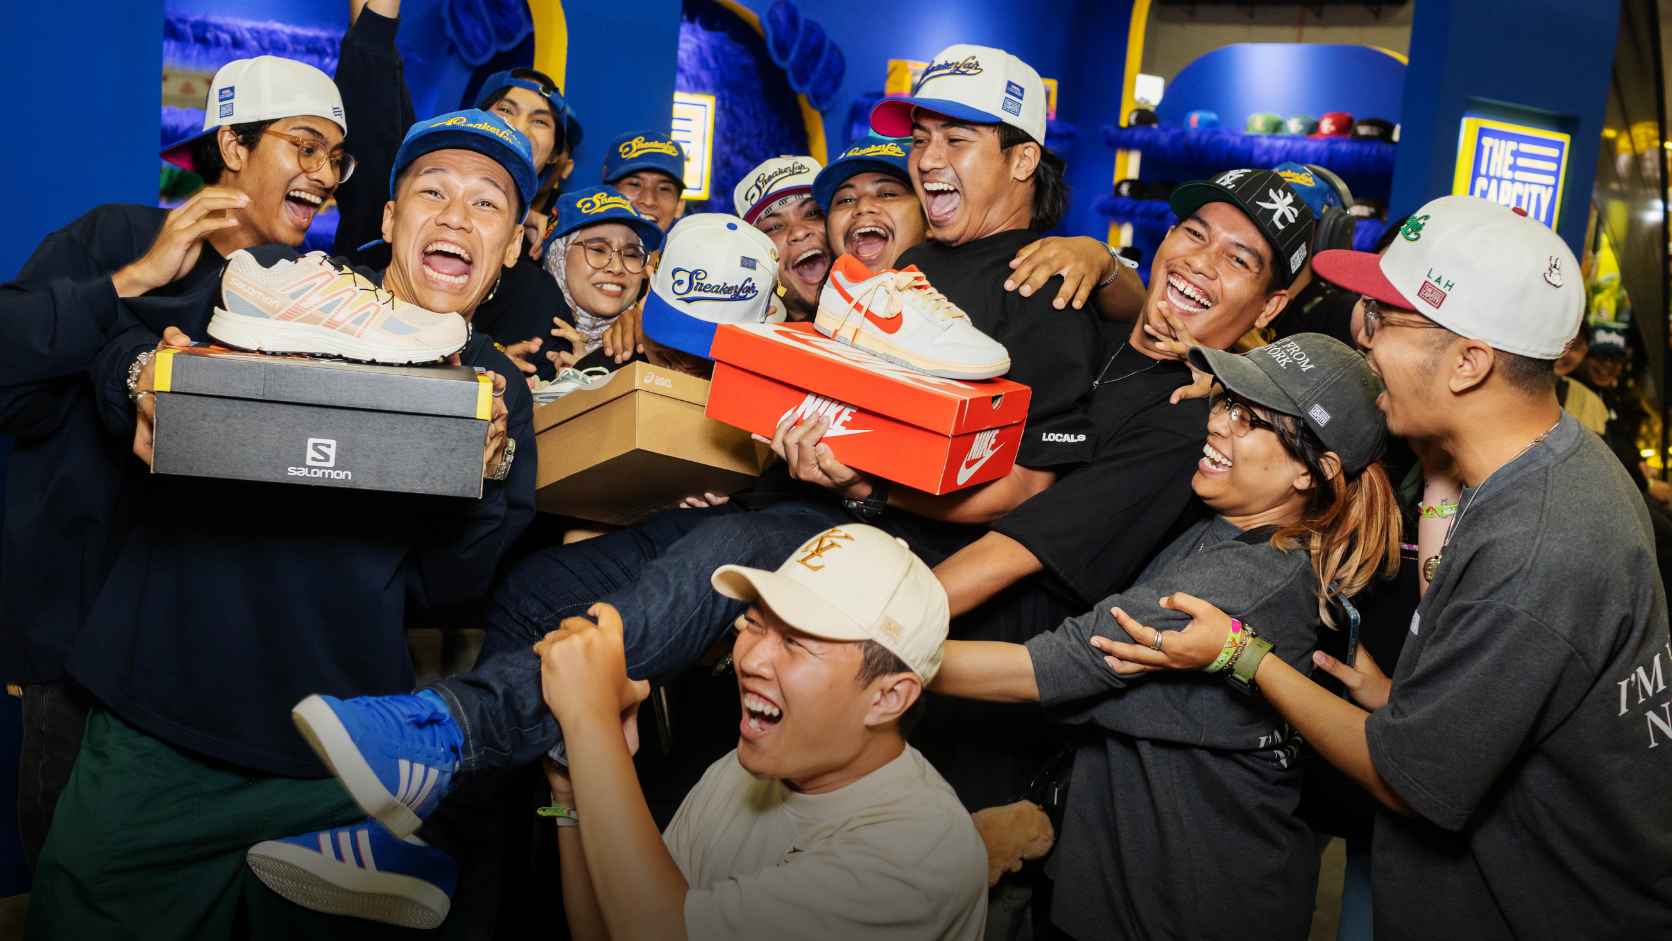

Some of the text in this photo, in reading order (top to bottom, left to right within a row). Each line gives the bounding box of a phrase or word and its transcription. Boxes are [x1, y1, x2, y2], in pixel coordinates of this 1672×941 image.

[1481, 136, 1519, 180] THE
[1426, 267, 1456, 292] LAH
[1282, 341, 1316, 372] FROM
[795, 392, 858, 431] NIKE
[967, 429, 1000, 462] NIKE
[1041, 432, 1087, 443] LOCALS
[1616, 653, 1668, 717] I'M
